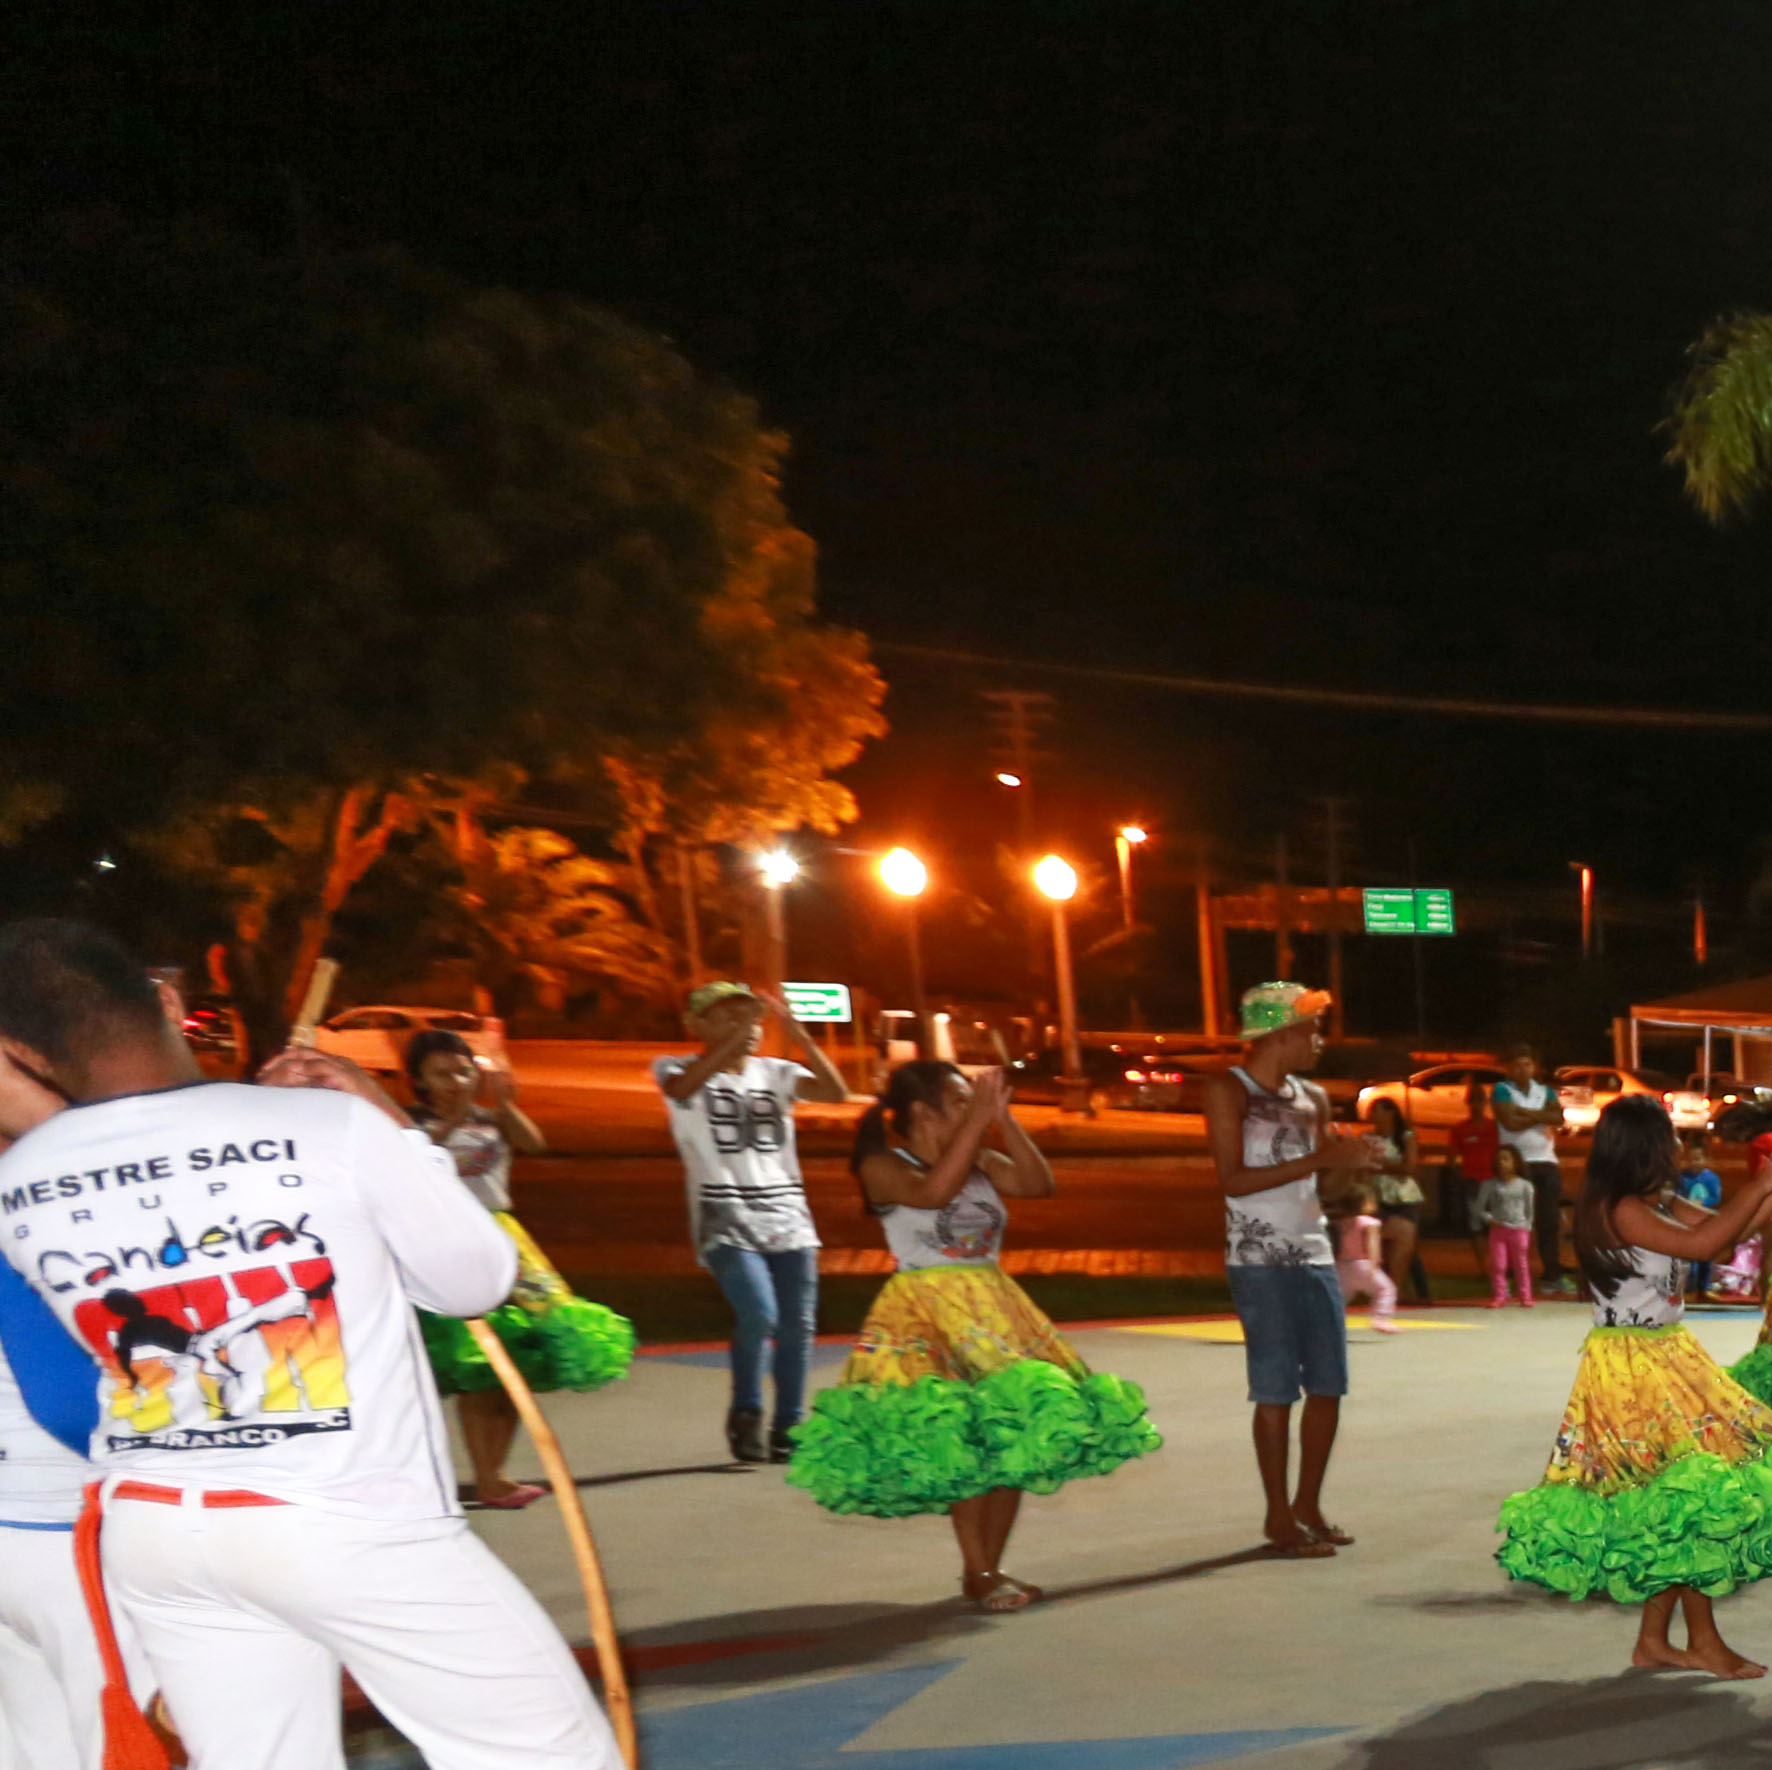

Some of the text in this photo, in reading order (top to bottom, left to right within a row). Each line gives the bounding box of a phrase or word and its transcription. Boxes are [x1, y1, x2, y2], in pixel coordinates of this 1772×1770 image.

[705, 1083, 785, 1153] 98
[0, 1138, 298, 1215] MESTRE SACI
[37, 1212, 327, 1292] Candeias
